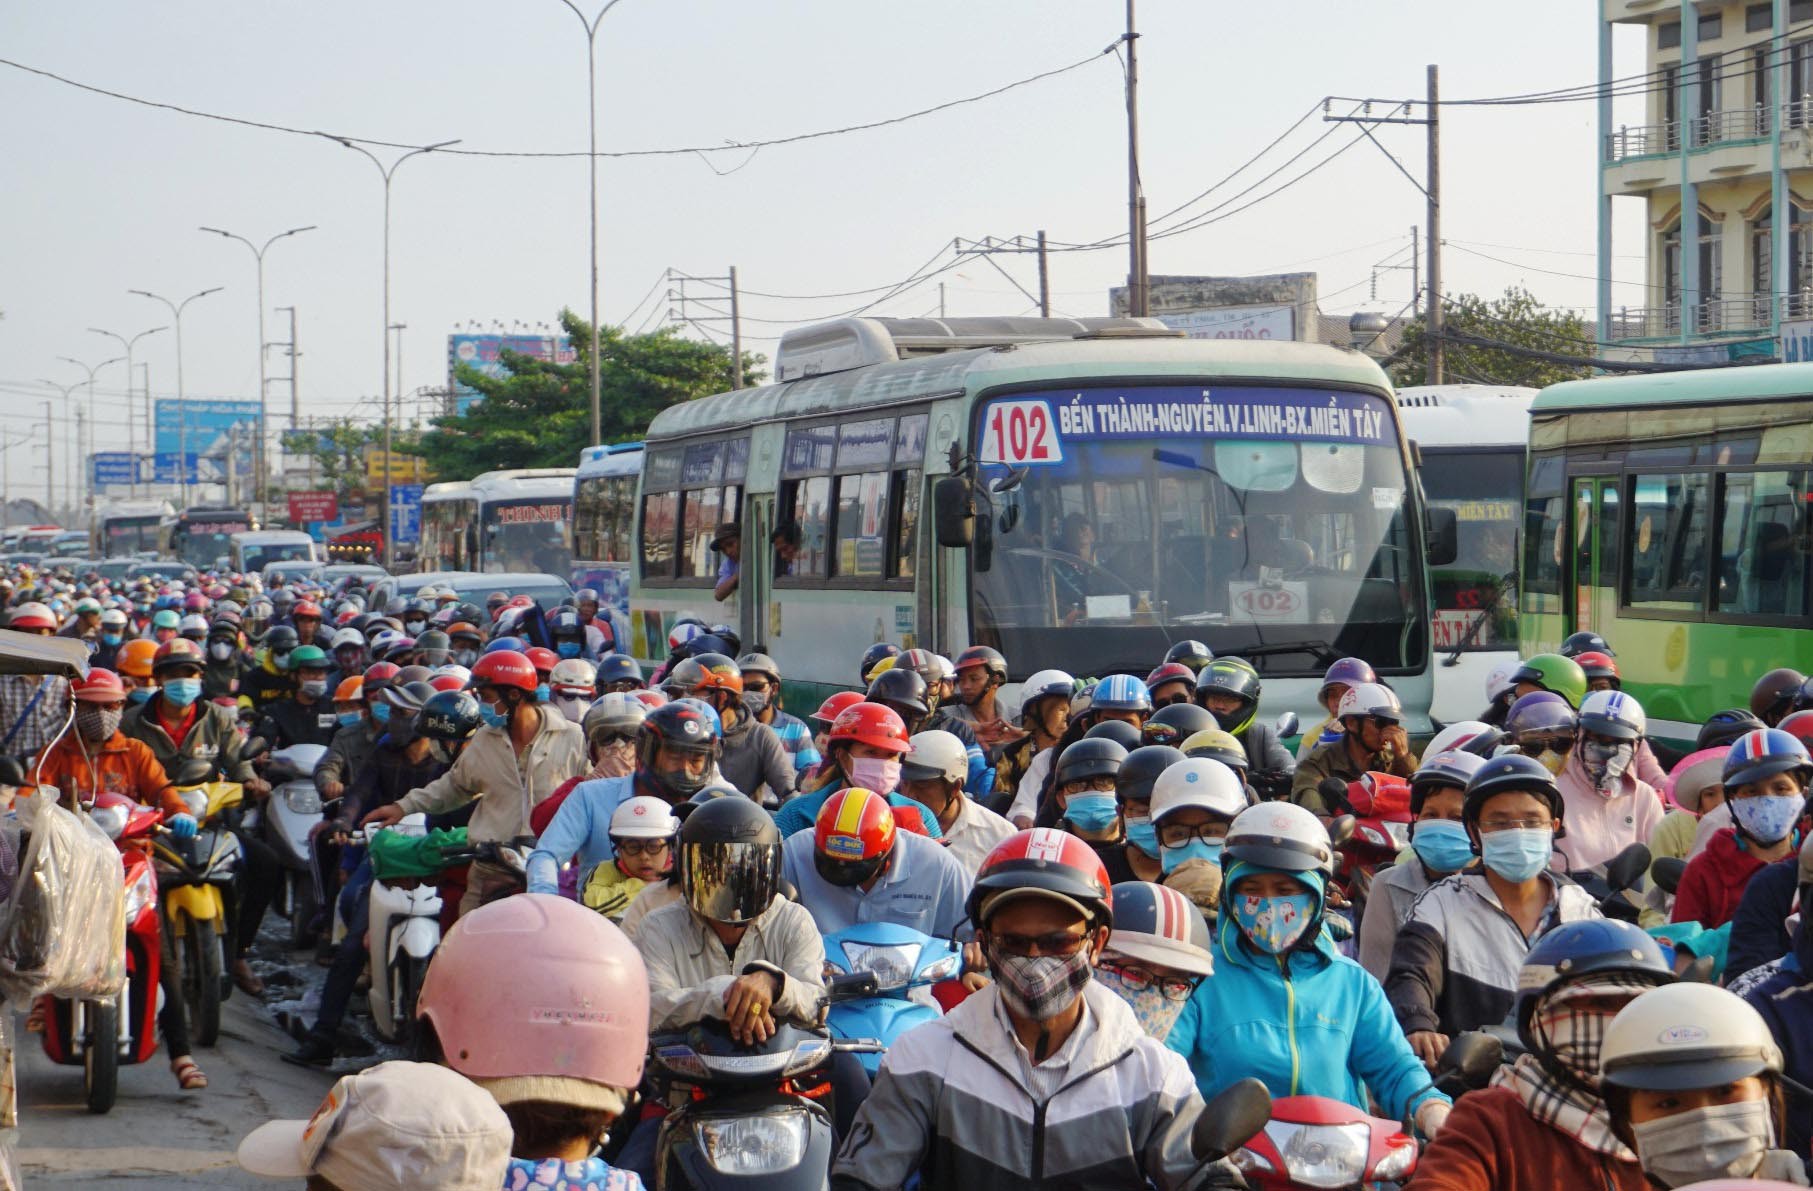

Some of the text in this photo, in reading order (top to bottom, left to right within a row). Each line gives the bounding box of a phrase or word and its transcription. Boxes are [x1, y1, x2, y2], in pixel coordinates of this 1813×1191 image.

[992, 406, 1048, 461] 102
[1059, 393, 1095, 434] BẾN
[1353, 403, 1382, 439] TÂY
[1243, 591, 1292, 612] 102
